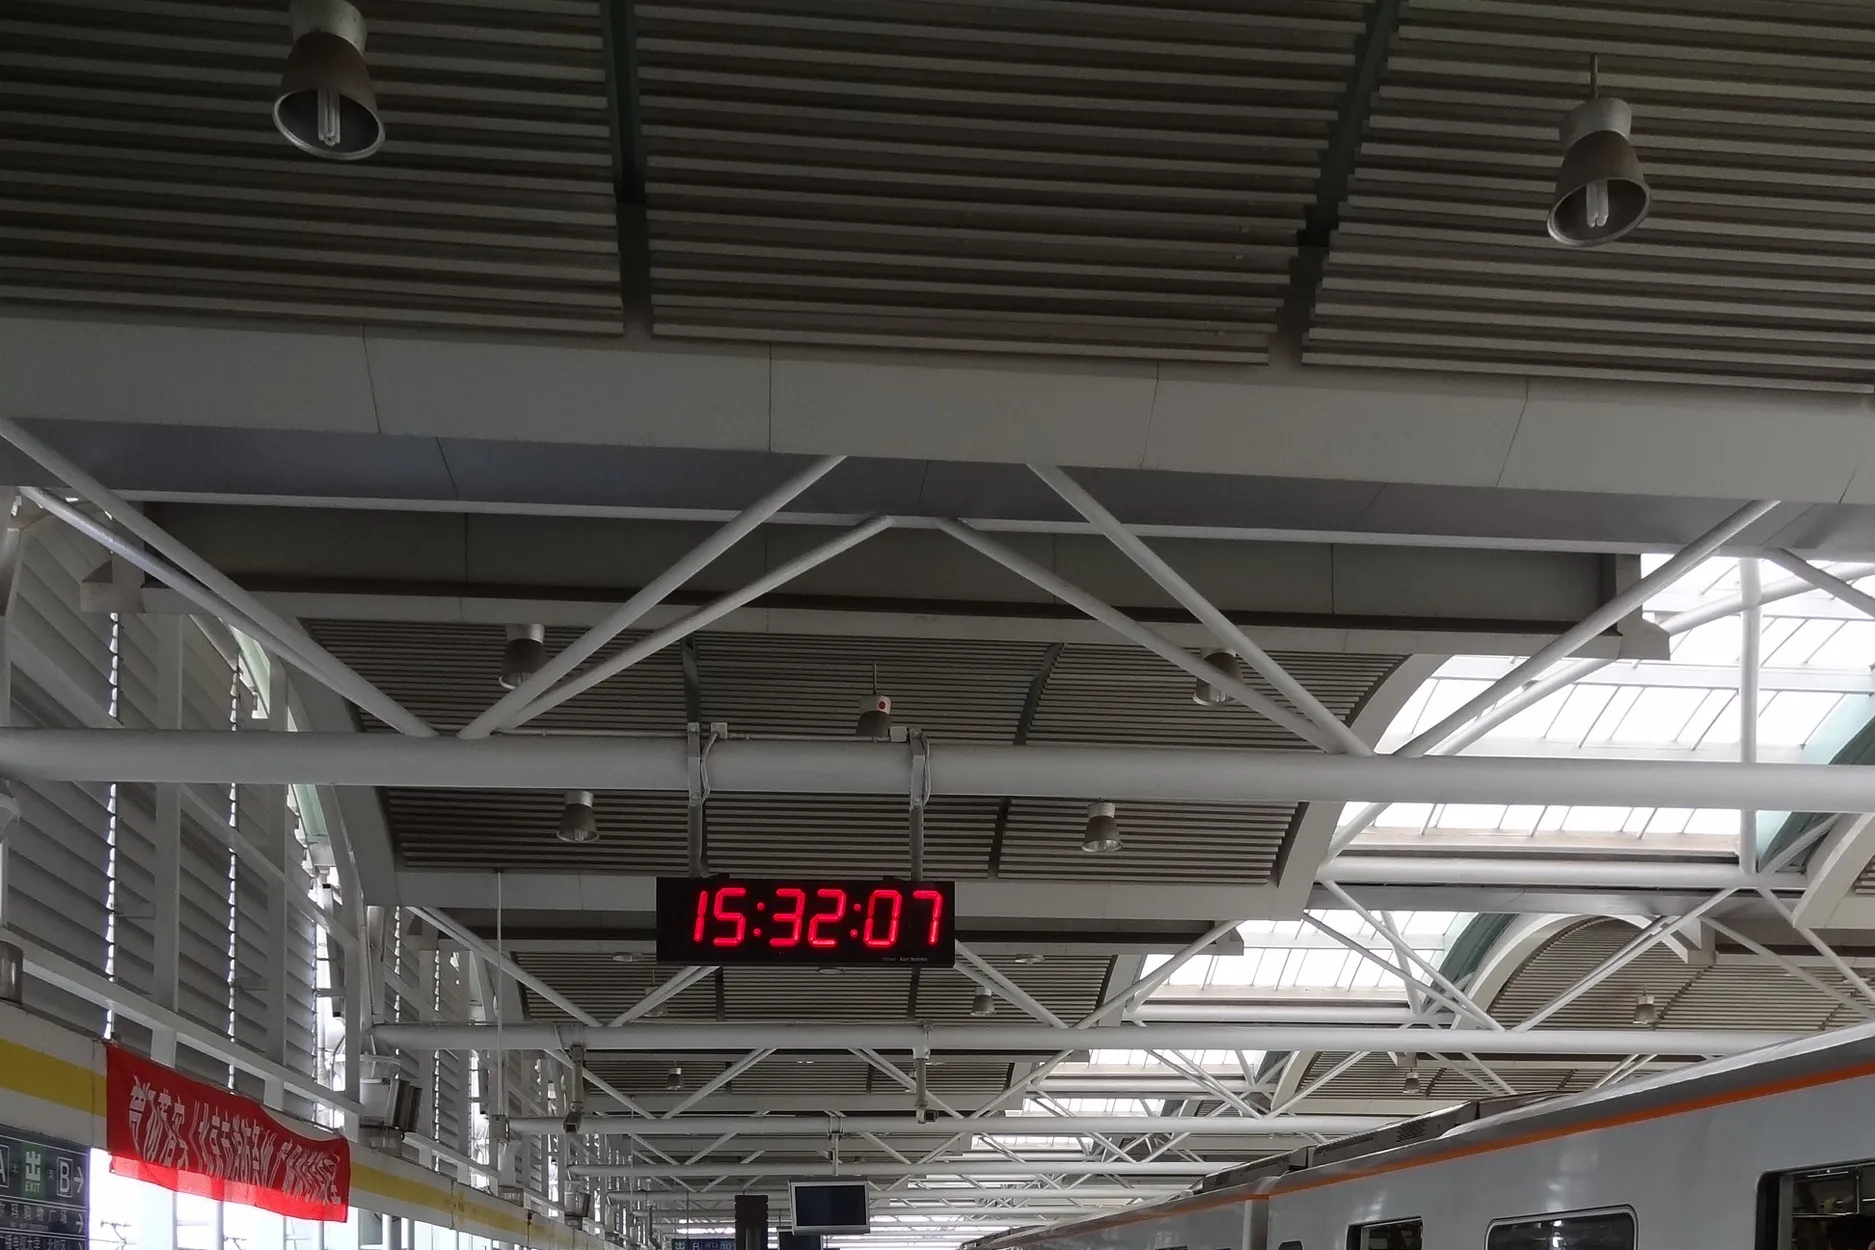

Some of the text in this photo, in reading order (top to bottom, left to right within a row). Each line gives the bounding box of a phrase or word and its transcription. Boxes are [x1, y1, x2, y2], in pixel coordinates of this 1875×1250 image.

[694, 887, 943, 947] 15:32:07
[25, 1181, 40, 1194] EXIT
[60, 1160, 70, 1193] B
